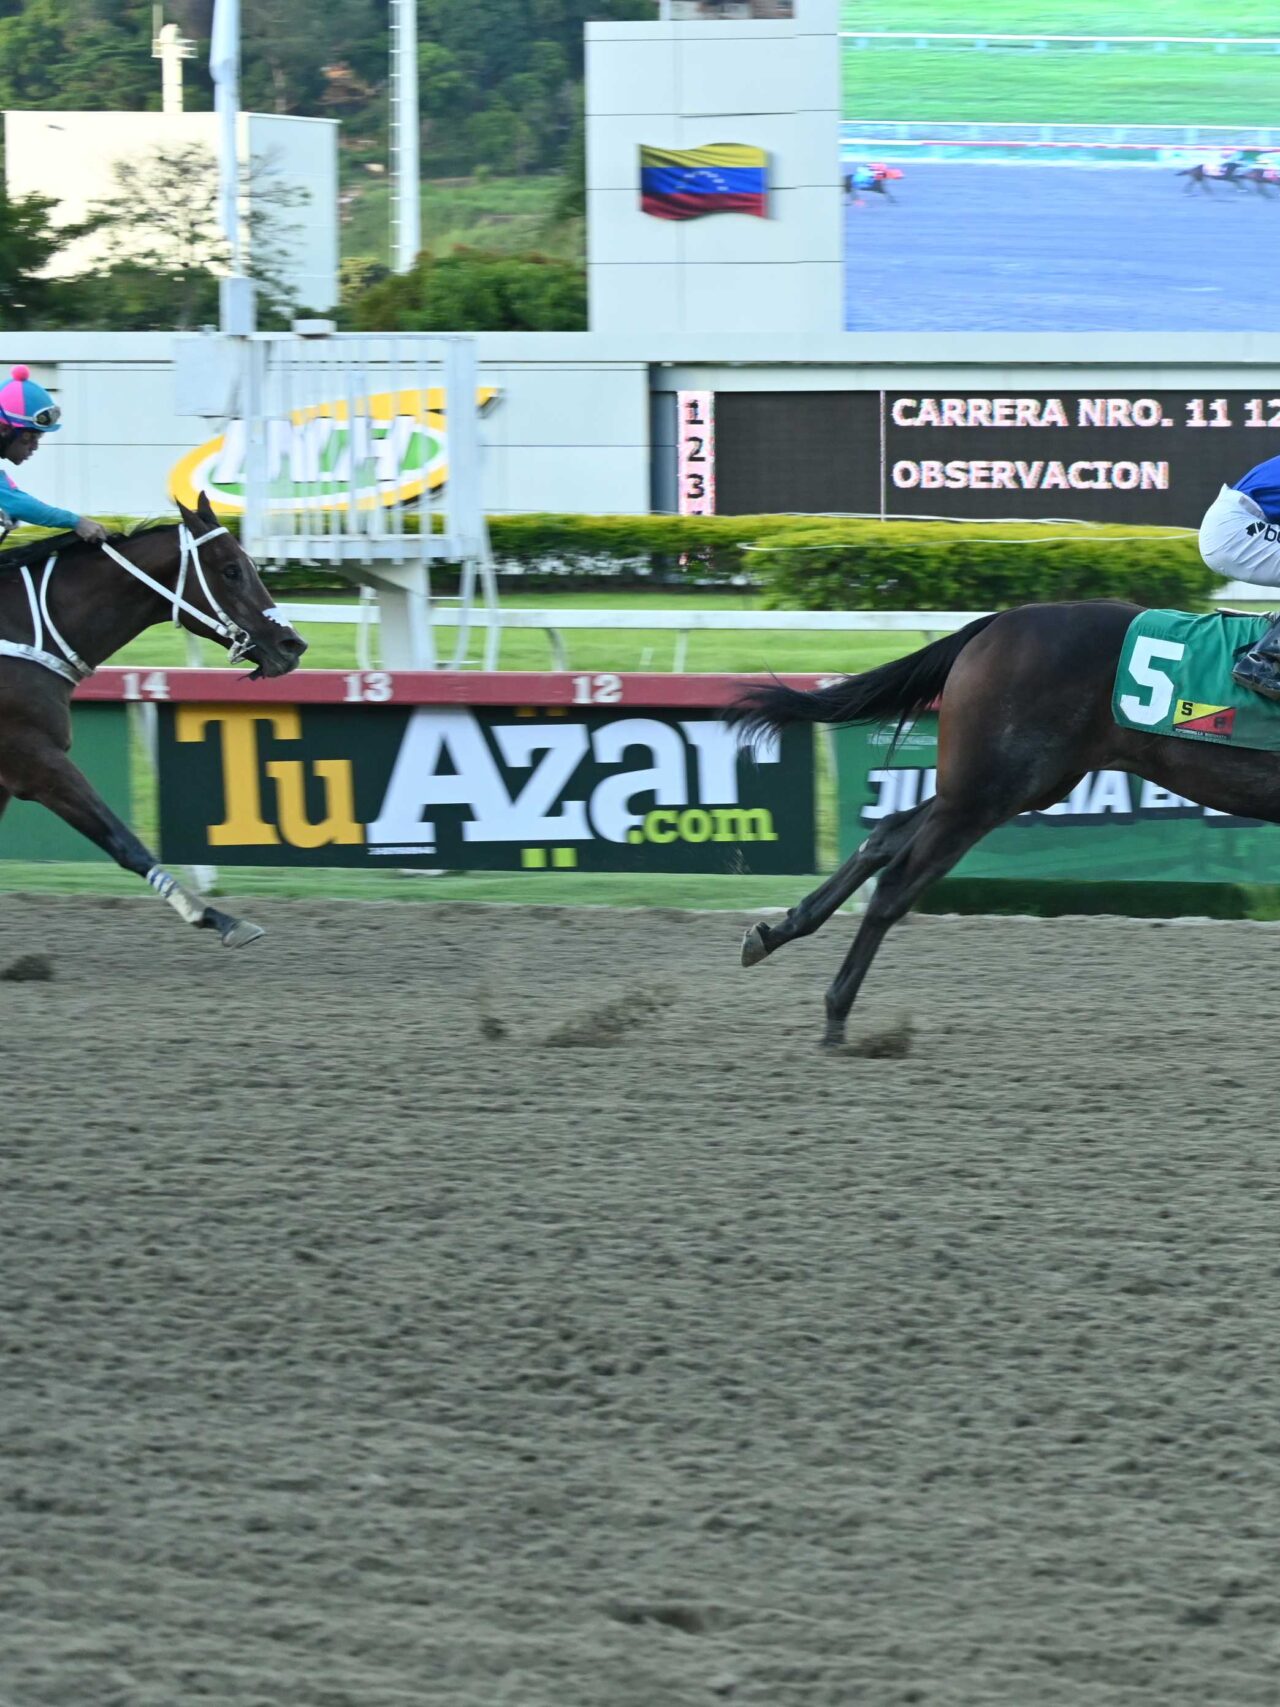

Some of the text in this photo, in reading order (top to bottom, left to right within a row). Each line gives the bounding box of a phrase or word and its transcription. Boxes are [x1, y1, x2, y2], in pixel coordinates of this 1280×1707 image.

[685, 400, 704, 425] 1
[892, 398, 1069, 427] CARRERA
[1077, 398, 1174, 428] NRO.
[1185, 398, 1232, 428] 11
[686, 436, 706, 462] 2
[686, 473, 705, 499] 3
[892, 460, 1170, 490] OBSERVACION
[122, 671, 170, 699] 14
[343, 672, 393, 702] 13
[572, 673, 623, 704] 12
[1119, 635, 1185, 725] 5
[1181, 701, 1194, 716] S
[627, 807, 779, 845] .com
